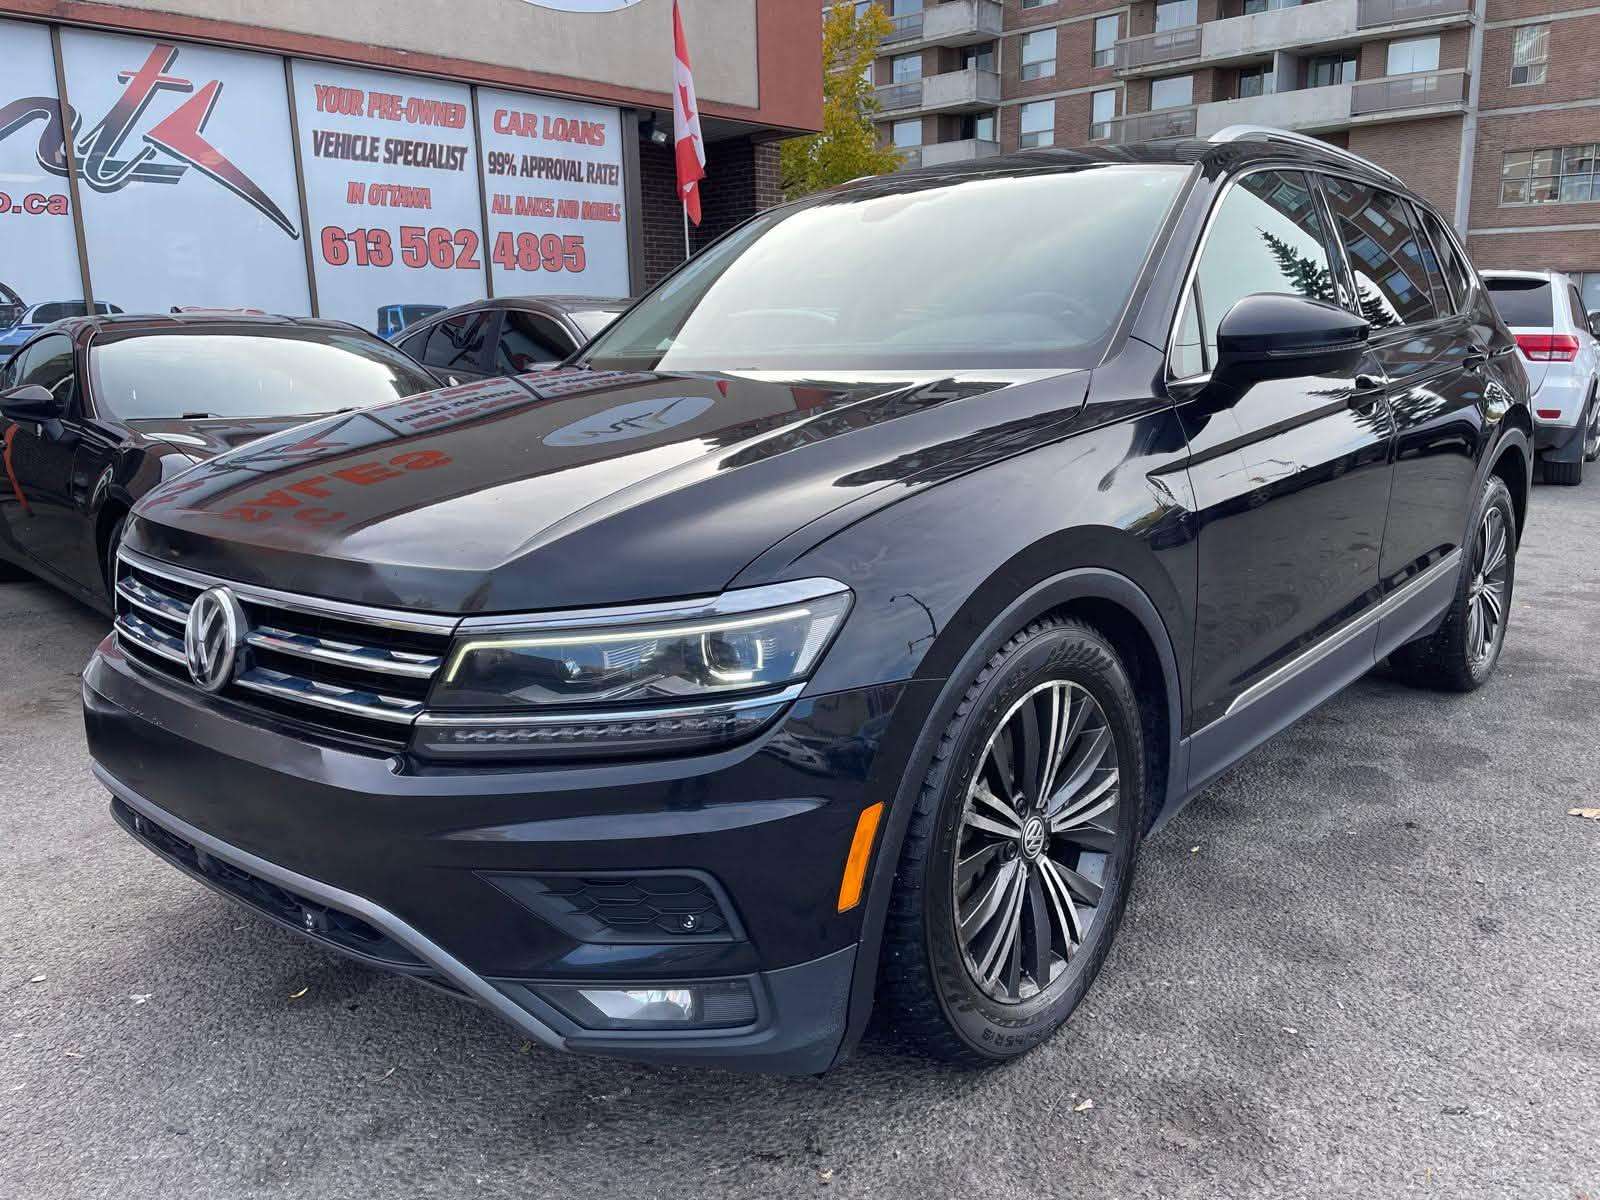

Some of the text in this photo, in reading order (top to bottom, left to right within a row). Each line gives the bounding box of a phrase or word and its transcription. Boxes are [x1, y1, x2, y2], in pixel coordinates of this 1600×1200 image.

[314, 84, 467, 129] YOUR PRE-OWNED
[493, 109, 606, 147] CAR LOANS
[312, 130, 468, 171] VEHICLE SPECIALIST
[488, 151, 619, 186] 99% APPROVAL RATE!
[346, 181, 432, 209] IN OTTAWA
[491, 193, 622, 222] ALL MAKES AND MODELS
[321, 226, 586, 273] 613 562 4895
